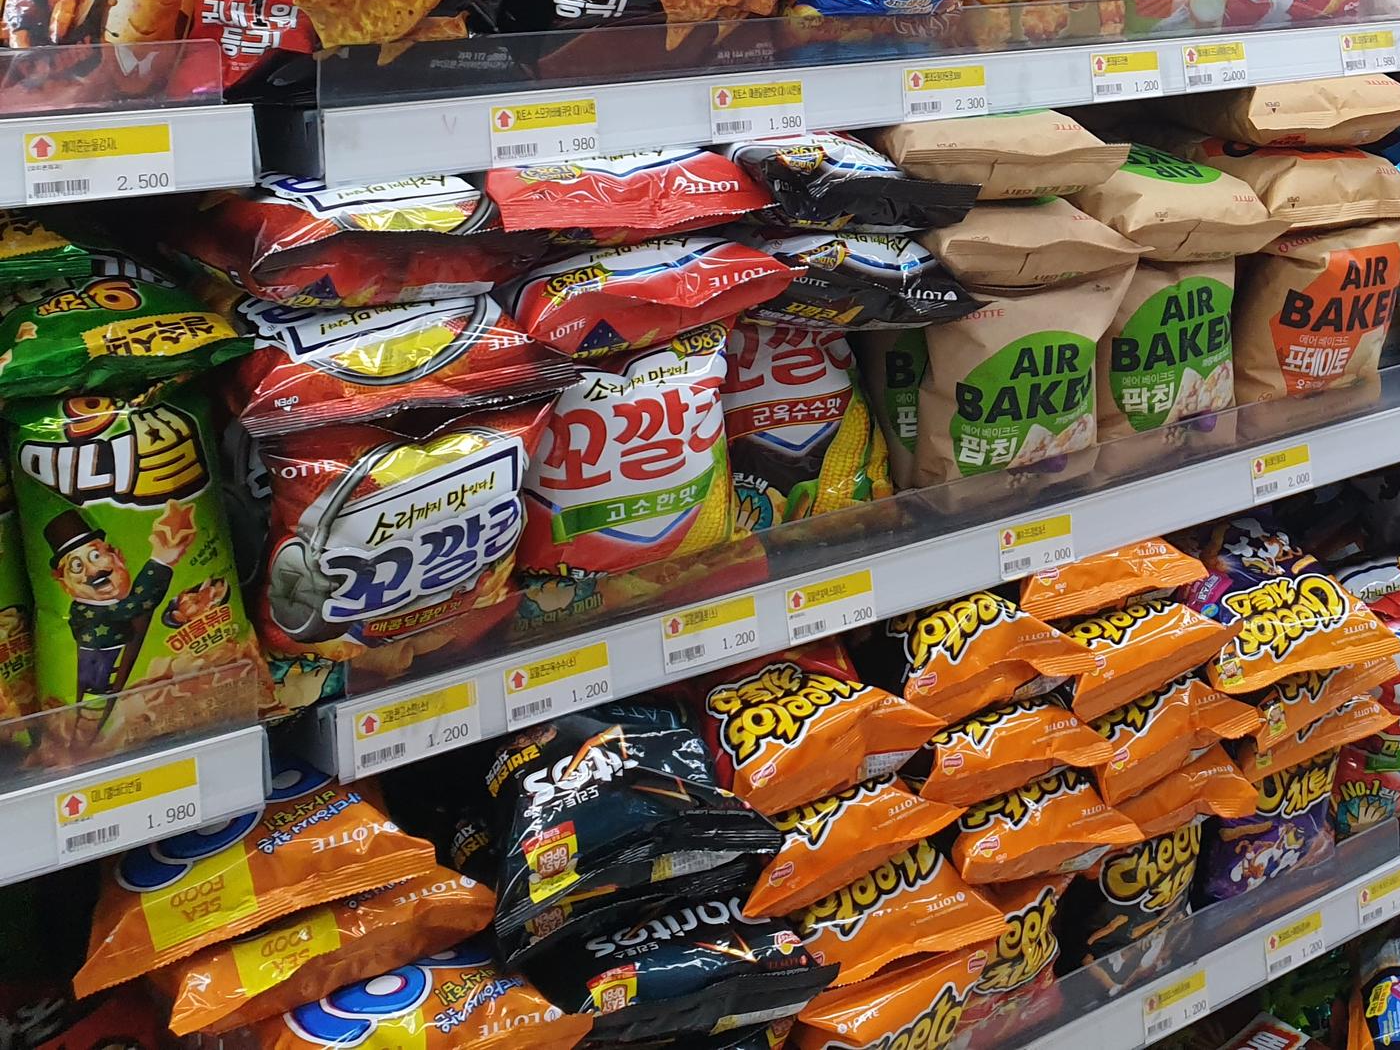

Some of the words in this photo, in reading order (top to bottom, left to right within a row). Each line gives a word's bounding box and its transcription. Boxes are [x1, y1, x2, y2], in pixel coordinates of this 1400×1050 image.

[1134, 79, 1160, 94] 1.200
[956, 97, 986, 112] 2.300
[768, 115, 802, 132] 1.980
[558, 136, 597, 154] 1.980
[117, 173, 169, 192] 2.500
[1340, 254, 1389, 293] AIR
[1160, 287, 1215, 328] AIR
[549, 318, 587, 341] LOTTE
[1010, 344, 1082, 380] AIR
[1283, 344, 1351, 376] 포테이토
[752, 397, 843, 427] 군옥수수맛
[1122, 386, 1178, 415] 팝칩
[958, 436, 1018, 469] 팝칩
[1288, 471, 1311, 486] 2.000
[366, 499, 443, 546] 소리까지
[445, 472, 497, 511] 맛있다!
[328, 502, 521, 619] 꼬깔콘
[1043, 546, 1072, 564] 2.000
[842, 606, 874, 626] 1.200
[722, 629, 757, 651] 1.200
[571, 679, 609, 703] 1.200
[427, 723, 470, 750] 1.200
[146, 802, 197, 832] 1.980
[169, 875, 225, 909] FOOD
[392, 878, 459, 908] LOTTE
[181, 896, 223, 923] SEA
